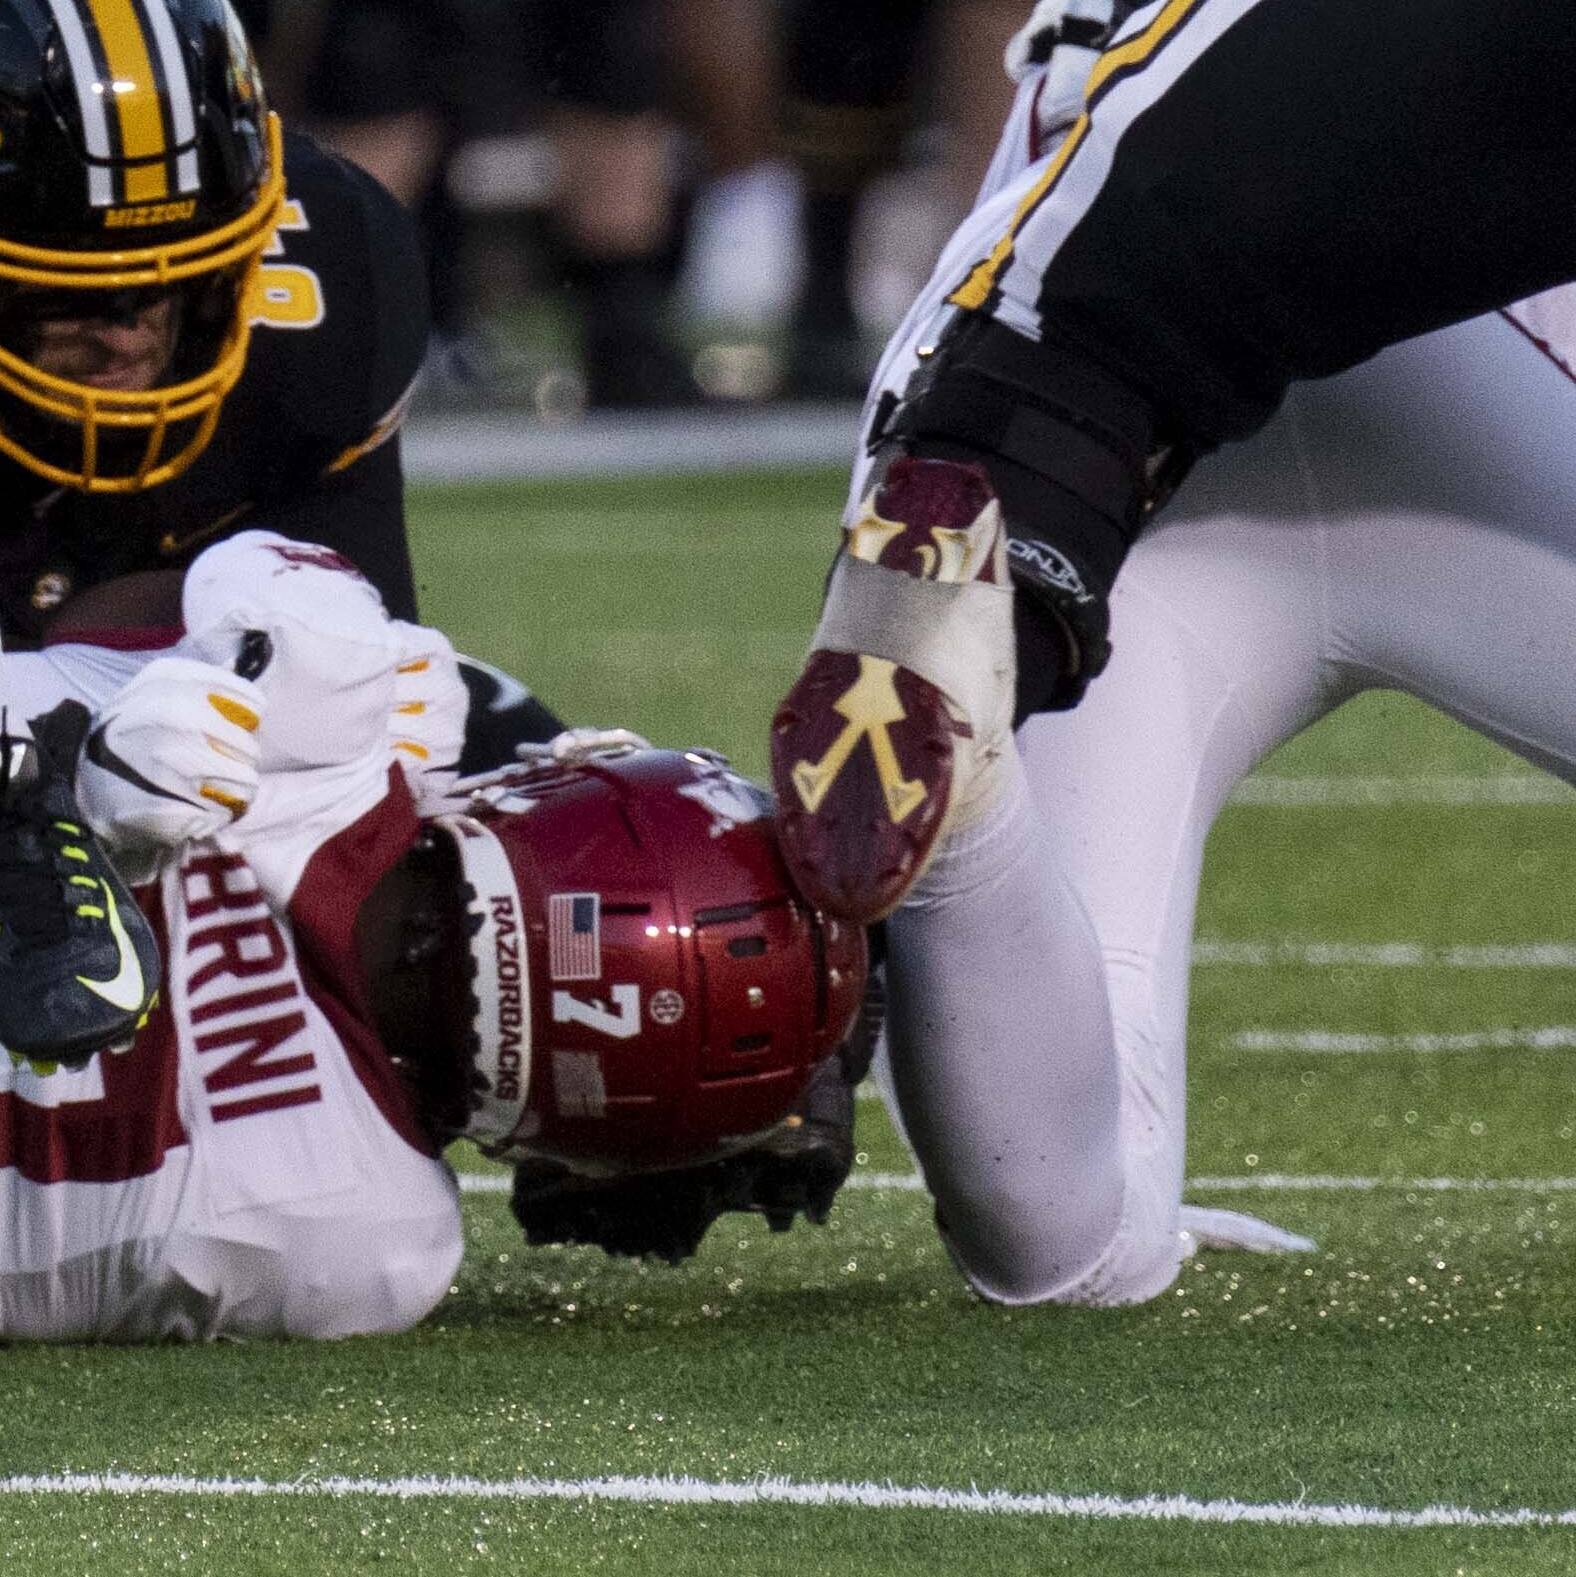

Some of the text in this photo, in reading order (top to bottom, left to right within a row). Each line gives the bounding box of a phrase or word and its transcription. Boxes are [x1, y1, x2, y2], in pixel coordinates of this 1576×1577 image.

[103, 198, 197, 228] MIZZOU
[489, 895, 524, 1102] RAZORBACKS
[552, 983, 641, 1040] 7
